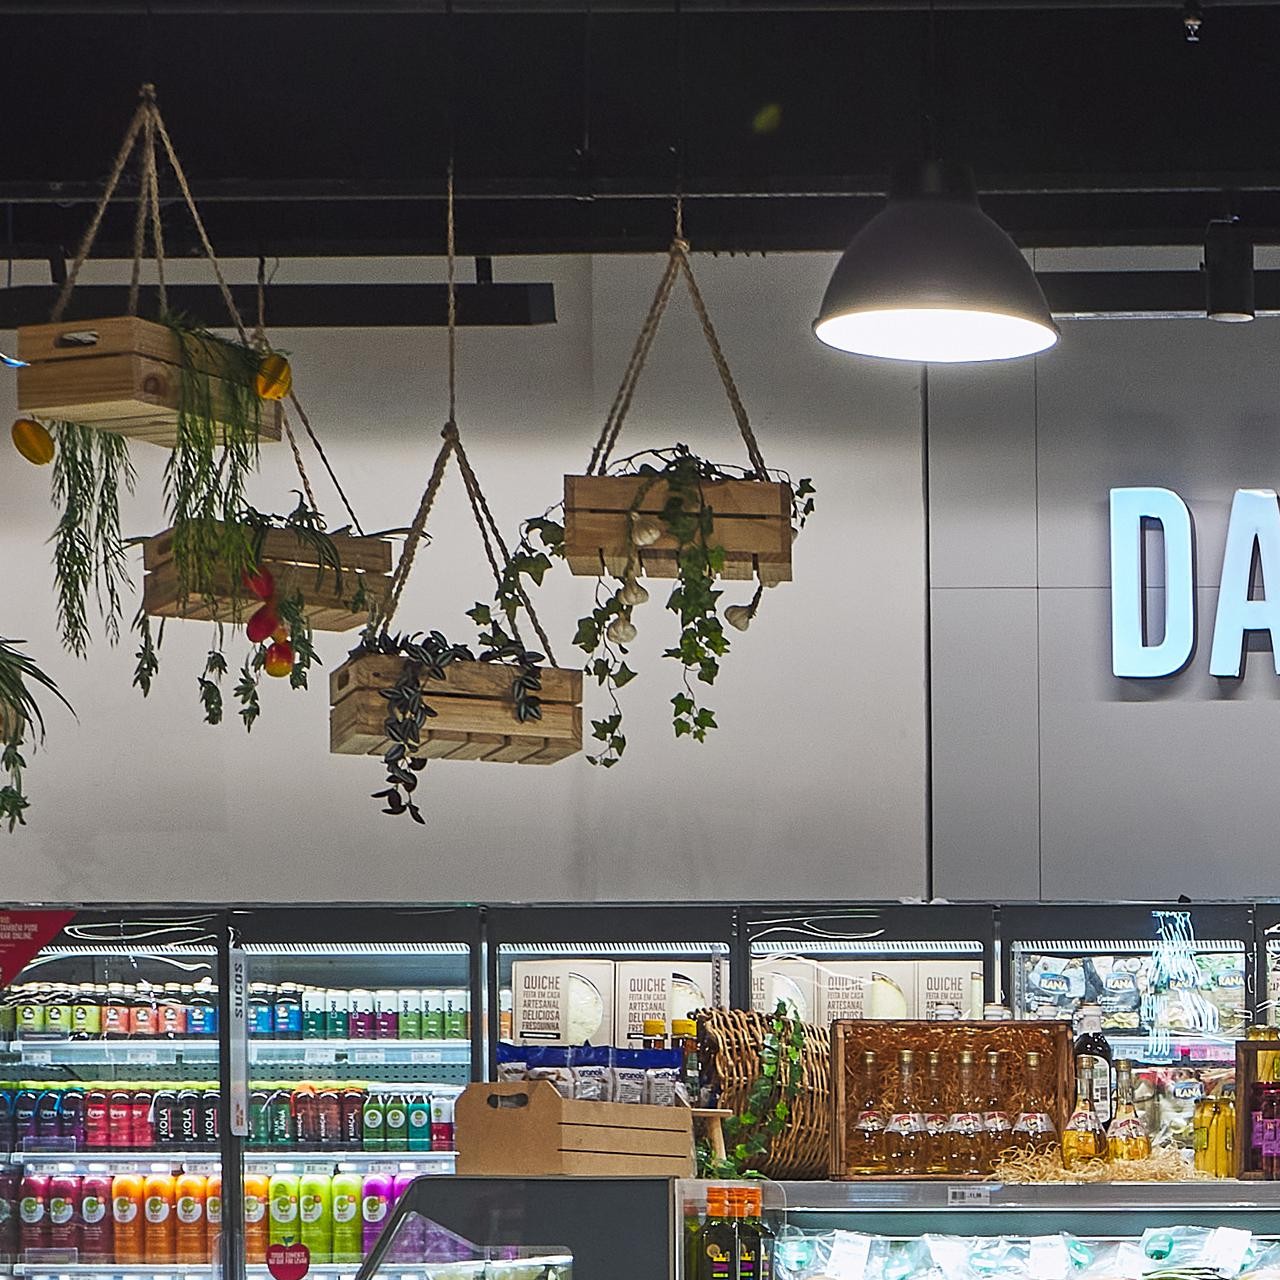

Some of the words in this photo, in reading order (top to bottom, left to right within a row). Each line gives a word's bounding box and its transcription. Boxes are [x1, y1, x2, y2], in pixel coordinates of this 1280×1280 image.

[523, 975, 560, 990] QUICHE
[629, 978, 666, 992] QUICHE
[926, 977, 964, 991] QUICHE
[1040, 976, 1069, 992] RANA
[1106, 977, 1135, 992] RANA
[1217, 975, 1245, 989] RANA
[234, 961, 244, 1019] SUCOS
[523, 991, 536, 999] FEITA
[537, 991, 545, 999] EM
[546, 991, 561, 999] CASA
[522, 1000, 560, 1010] ARTESANAL
[522, 1010, 560, 1021] DELICIOSA
[628, 1012, 667, 1021] DELICIOSA
[521, 1021, 560, 1031] FRESQUINHA
[159, 1108, 169, 1135] KOLA
[183, 1108, 193, 1135] KOLA
